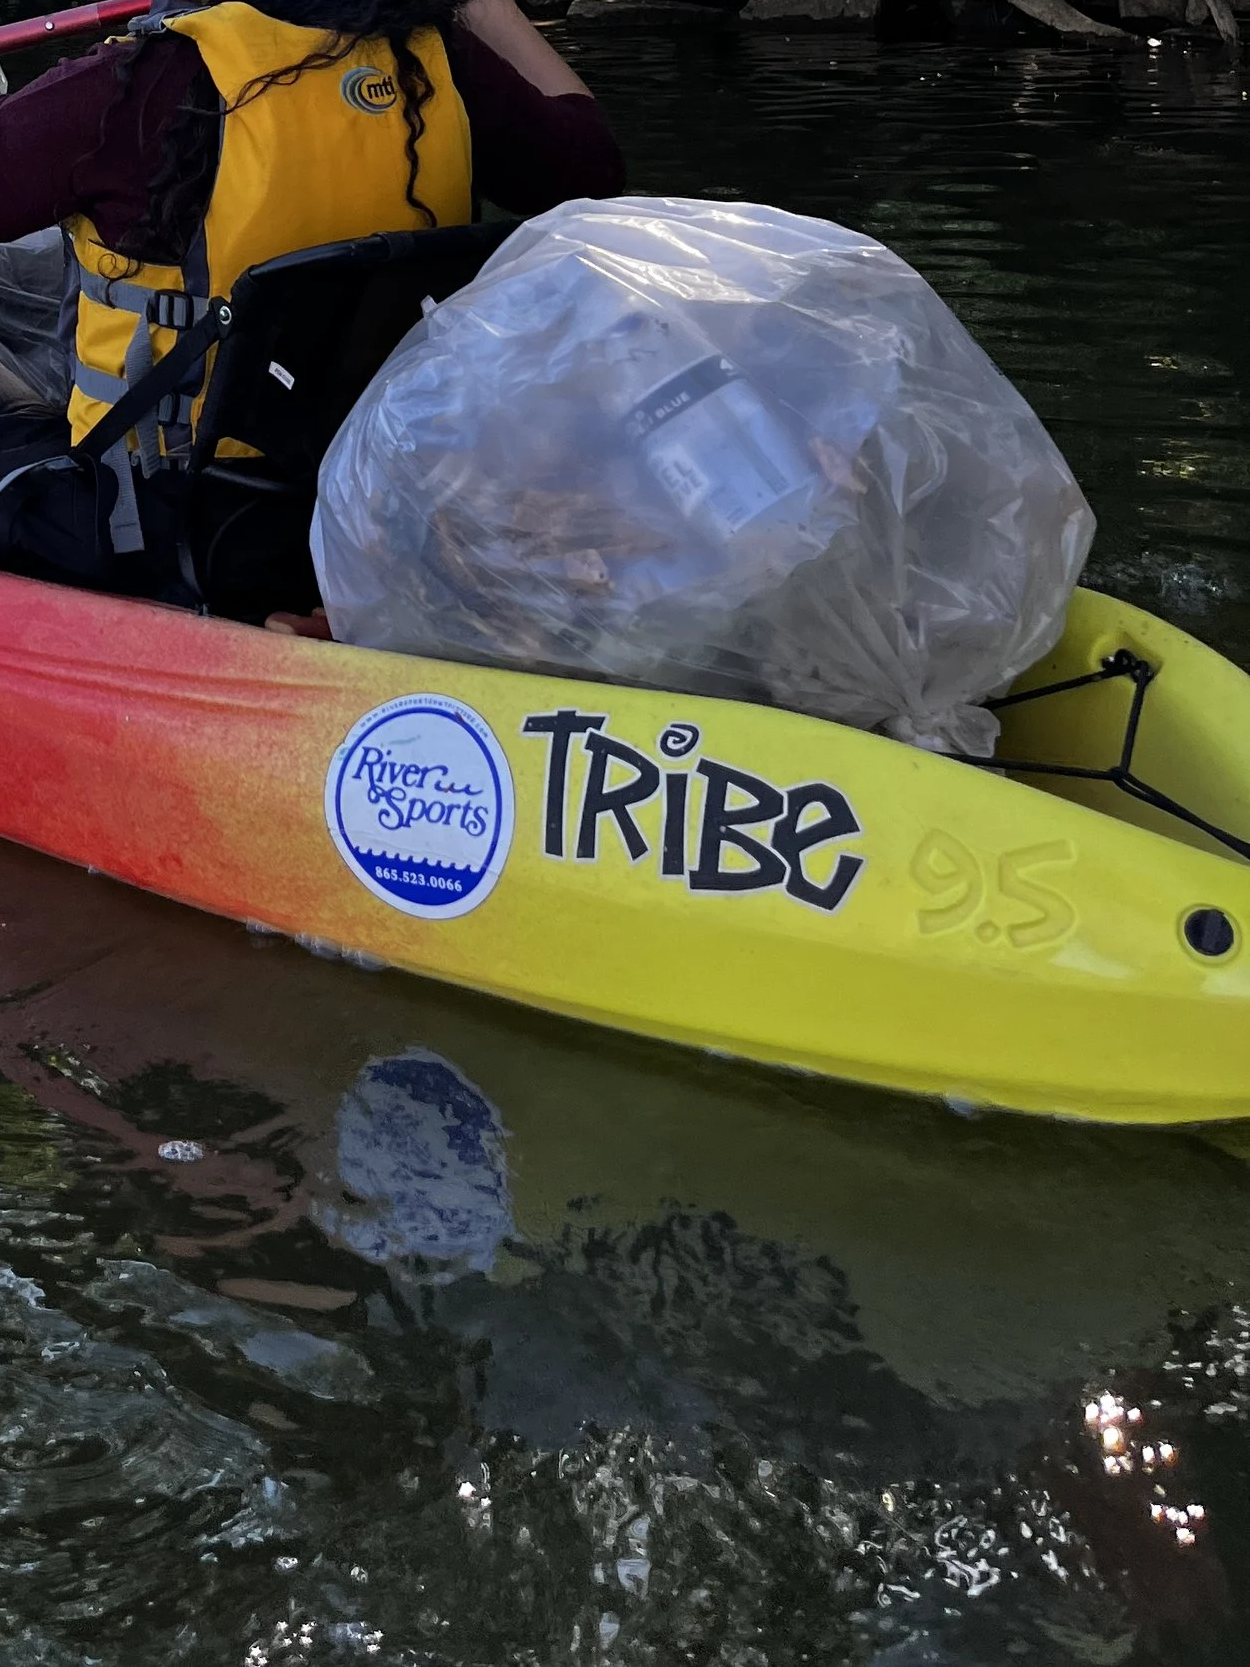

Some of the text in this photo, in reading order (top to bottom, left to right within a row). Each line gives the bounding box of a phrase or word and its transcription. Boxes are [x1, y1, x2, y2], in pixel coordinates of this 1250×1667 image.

[366, 75, 396, 100] mti
[352, 746, 449, 794] River
[376, 786, 490, 837] Sports
[374, 865, 463, 893] 865.523.0066
[908, 827, 1079, 951] 9.5
